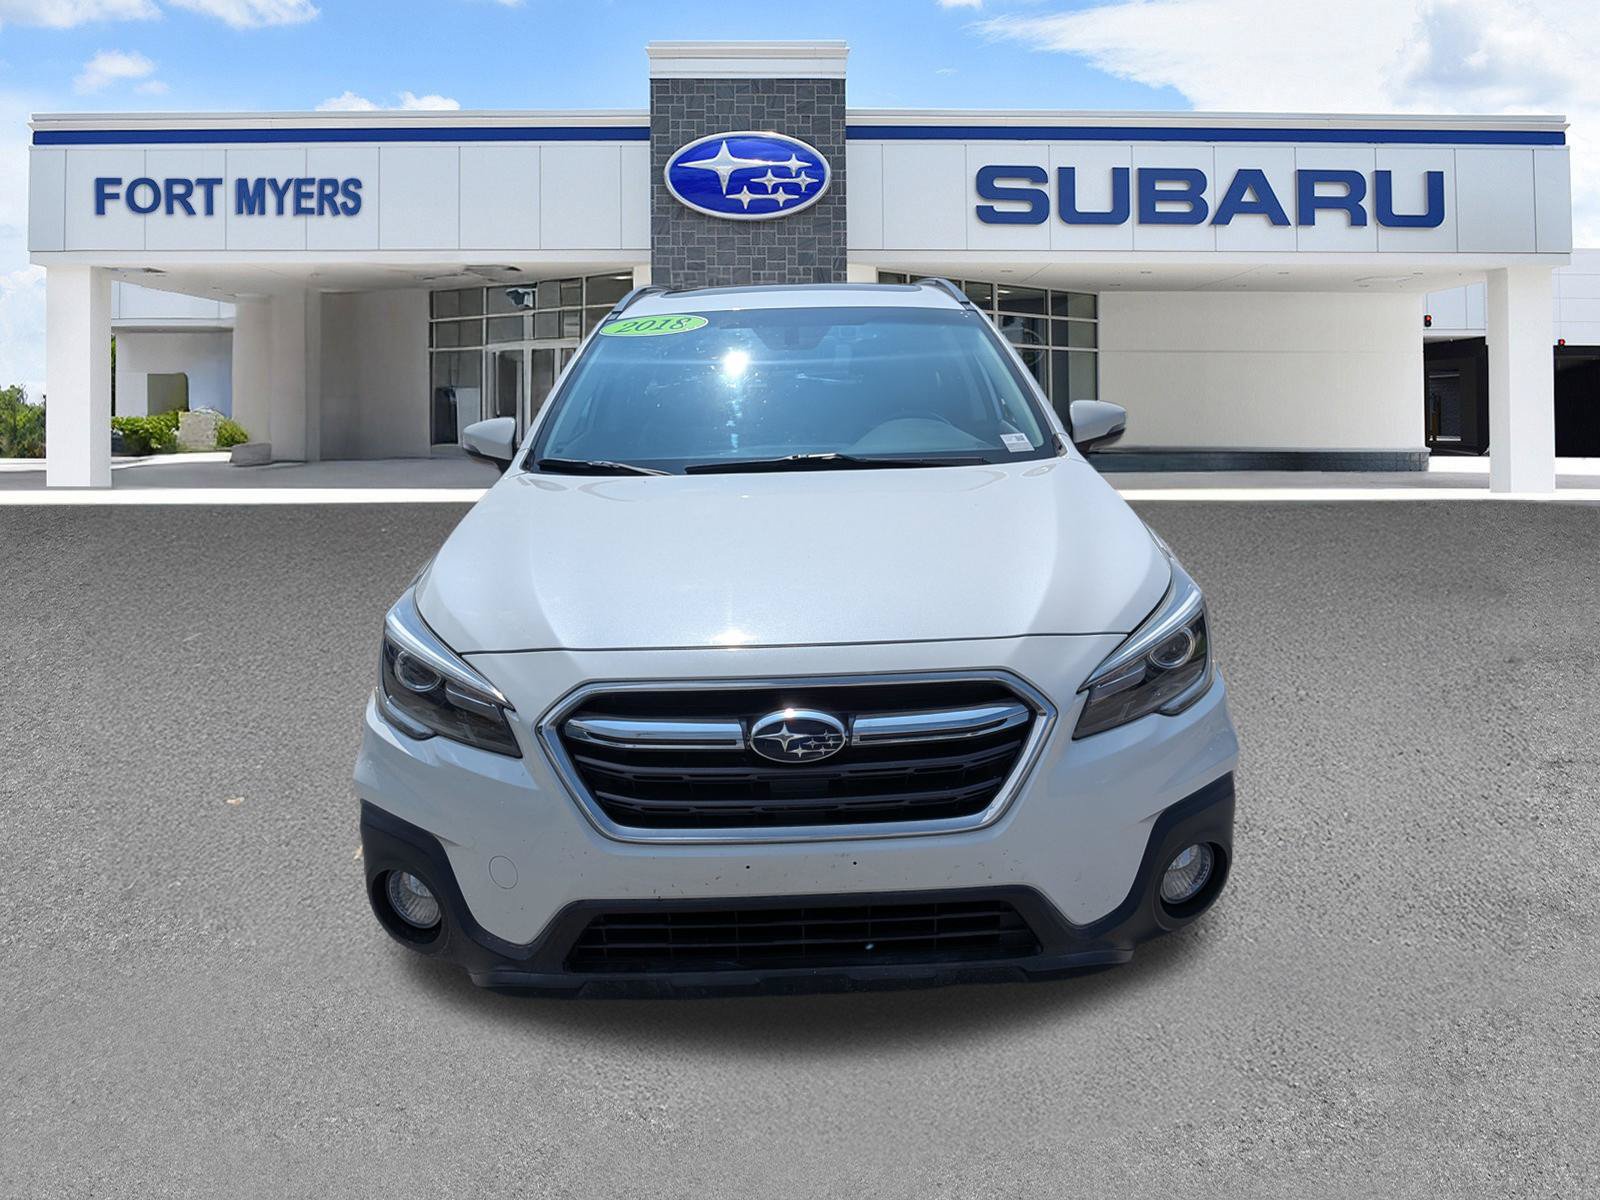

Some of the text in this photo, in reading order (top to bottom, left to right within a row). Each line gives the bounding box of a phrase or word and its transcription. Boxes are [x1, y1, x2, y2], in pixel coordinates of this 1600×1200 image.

[94, 177, 363, 216] FORT MYERS
[976, 165, 1446, 229] SUBARU
[614, 317, 692, 334] 2018
